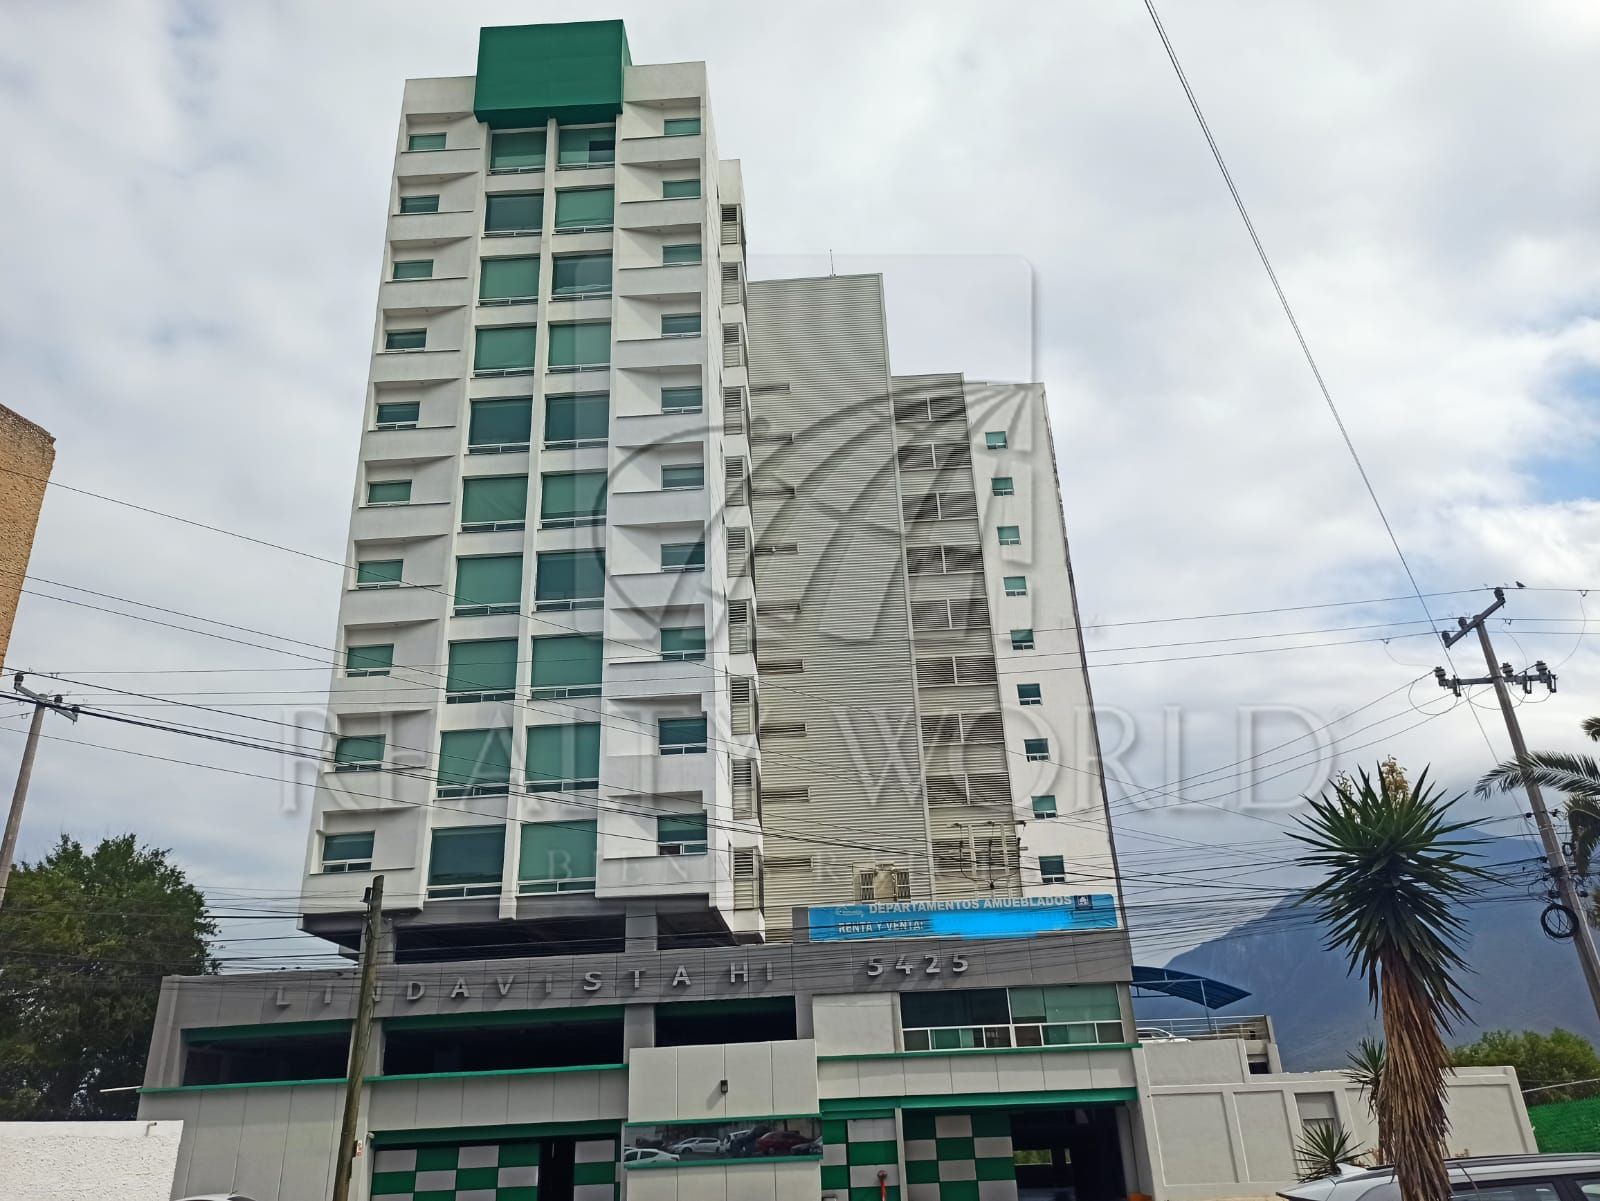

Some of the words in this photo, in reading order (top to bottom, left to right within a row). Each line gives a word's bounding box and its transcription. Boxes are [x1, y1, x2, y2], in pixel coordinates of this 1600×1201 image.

[869, 900, 979, 914] DEPARTAMENTOS
[984, 895, 1072, 909] AMUEBLADOS
[839, 922, 873, 933] RENTA
[867, 953, 969, 977] 5425
